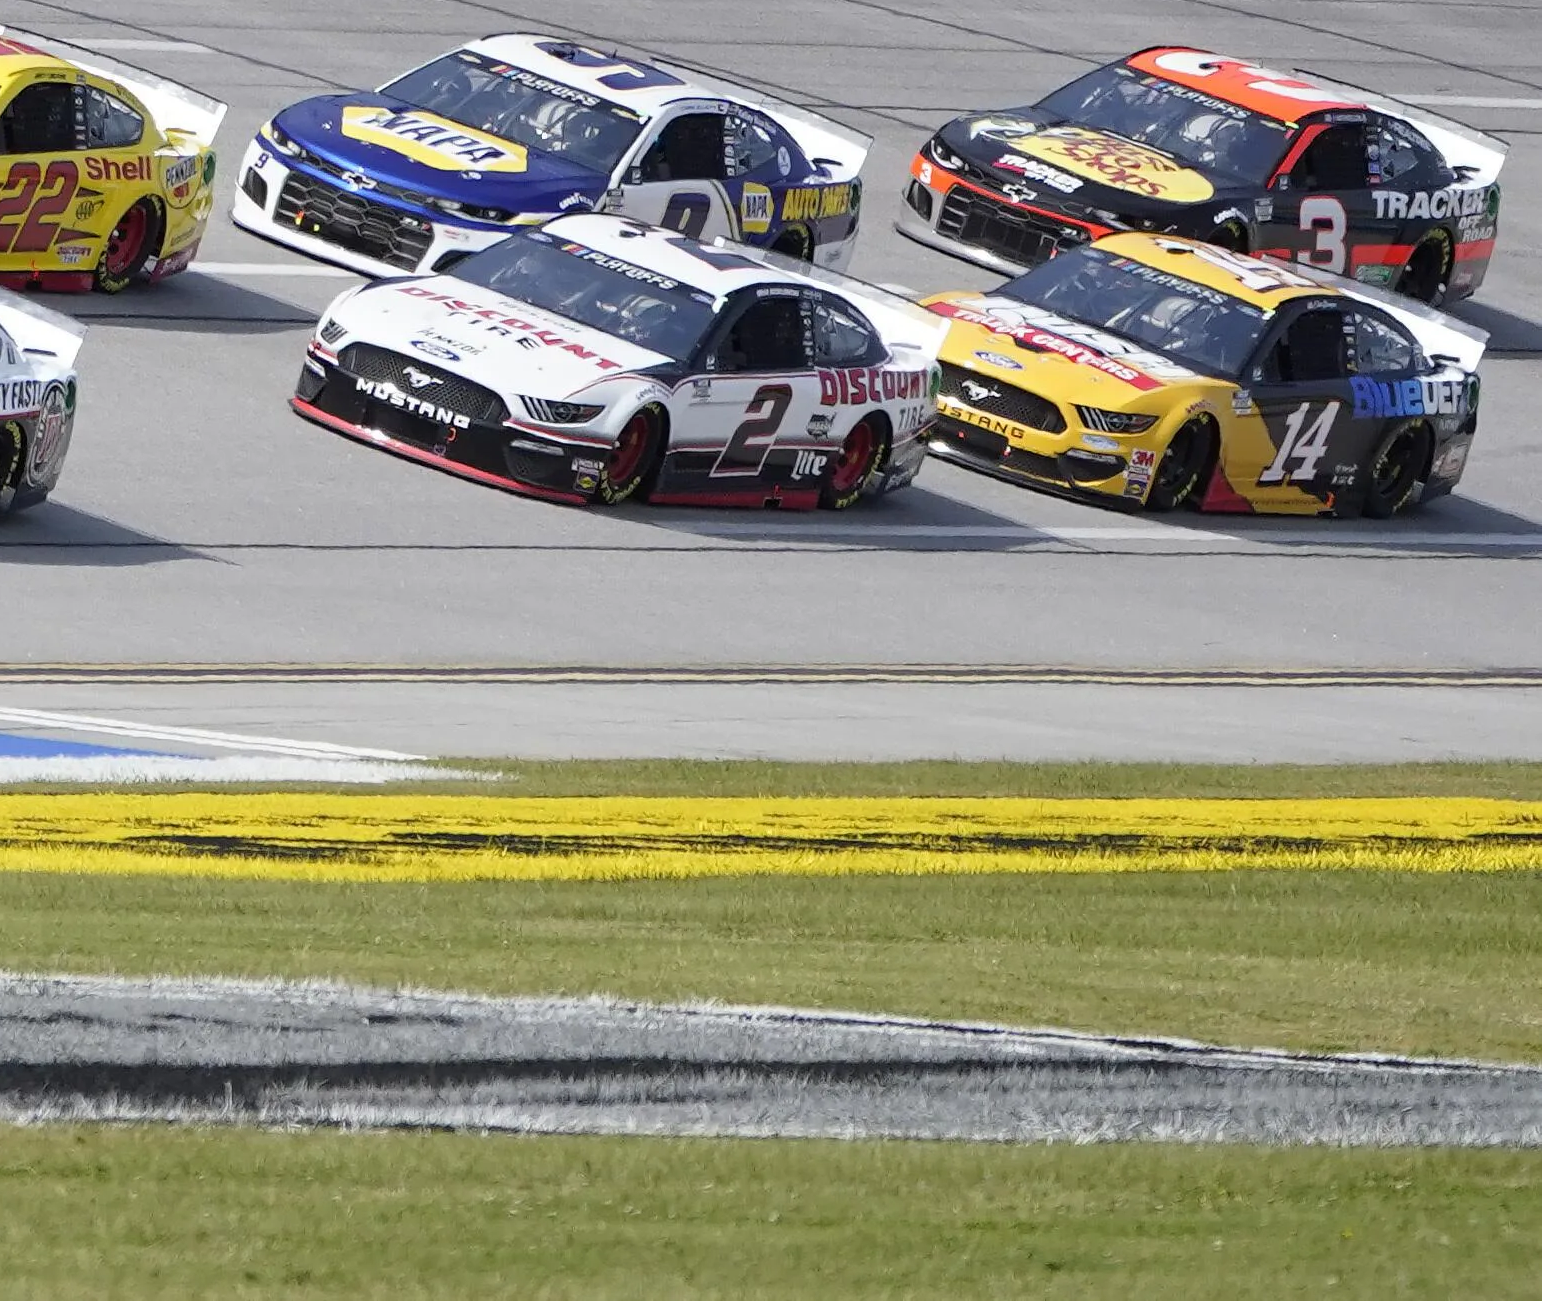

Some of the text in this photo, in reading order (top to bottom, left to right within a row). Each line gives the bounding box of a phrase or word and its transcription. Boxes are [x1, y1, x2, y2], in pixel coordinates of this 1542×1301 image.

[512, 71, 602, 107] PLAYOFFS
[359, 112, 506, 165] NAPA
[84, 155, 152, 182] Shell
[919, 162, 933, 185] 3
[745, 193, 768, 220] NAPA
[1371, 187, 1487, 220] TRACKER
[1297, 195, 1348, 276] 3
[584, 251, 679, 290] PLAYOFFS
[395, 286, 623, 370] DISCOUNT
[953, 308, 1139, 381] TRUCK CENTERS
[355, 377, 471, 429] MUSTANG
[817, 368, 929, 406] DISCOUNT
[708, 382, 793, 478] 2
[897, 404, 925, 432] TIRE
[1133, 448, 1155, 466] 3M
[1256, 400, 1341, 486] 14
[789, 450, 828, 481] lite
